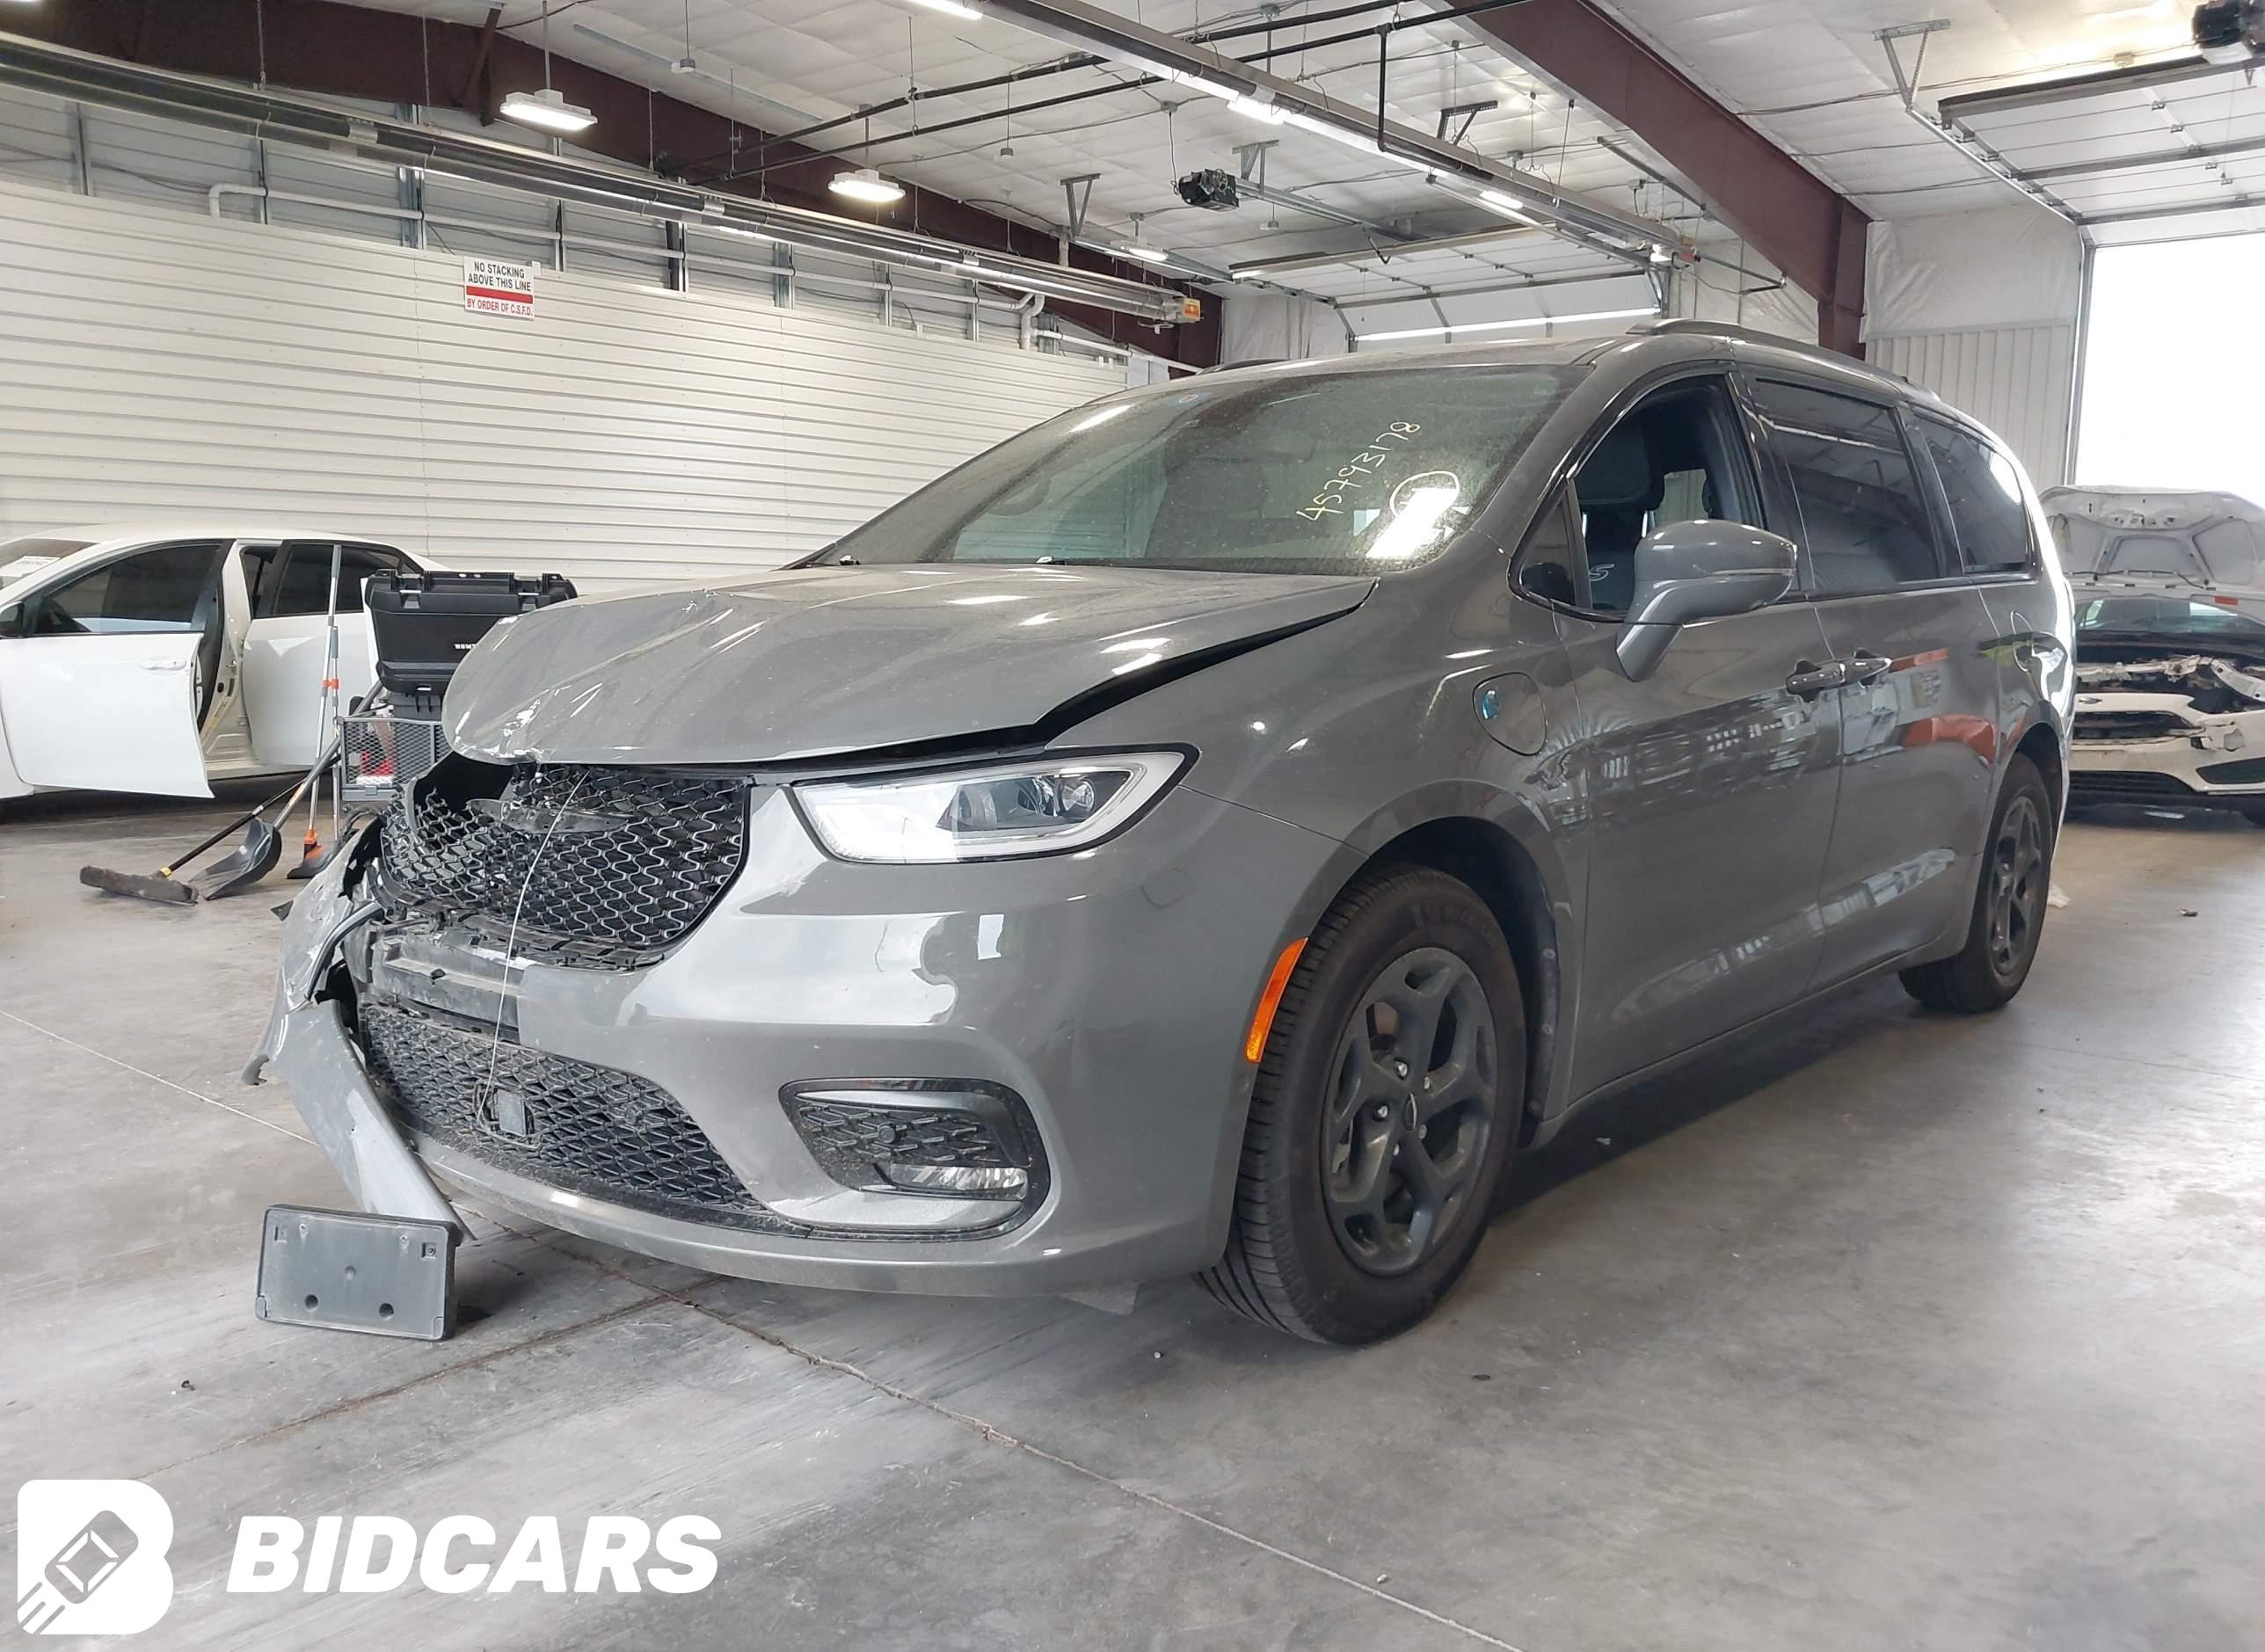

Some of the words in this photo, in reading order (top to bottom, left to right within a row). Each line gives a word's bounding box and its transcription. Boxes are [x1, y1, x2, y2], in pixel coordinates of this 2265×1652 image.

[475, 261, 485, 273] NO
[488, 264, 525, 279] STACKING
[469, 273, 494, 287] ABOVE
[496, 277, 513, 289] THIS
[515, 280, 531, 292] LINE
[467, 298, 477, 309] BY
[477, 300, 499, 311] ORDER
[500, 302, 509, 313] OF
[511, 304, 534, 317] C.S.F.D.
[1296, 421, 1421, 521] 45793178
